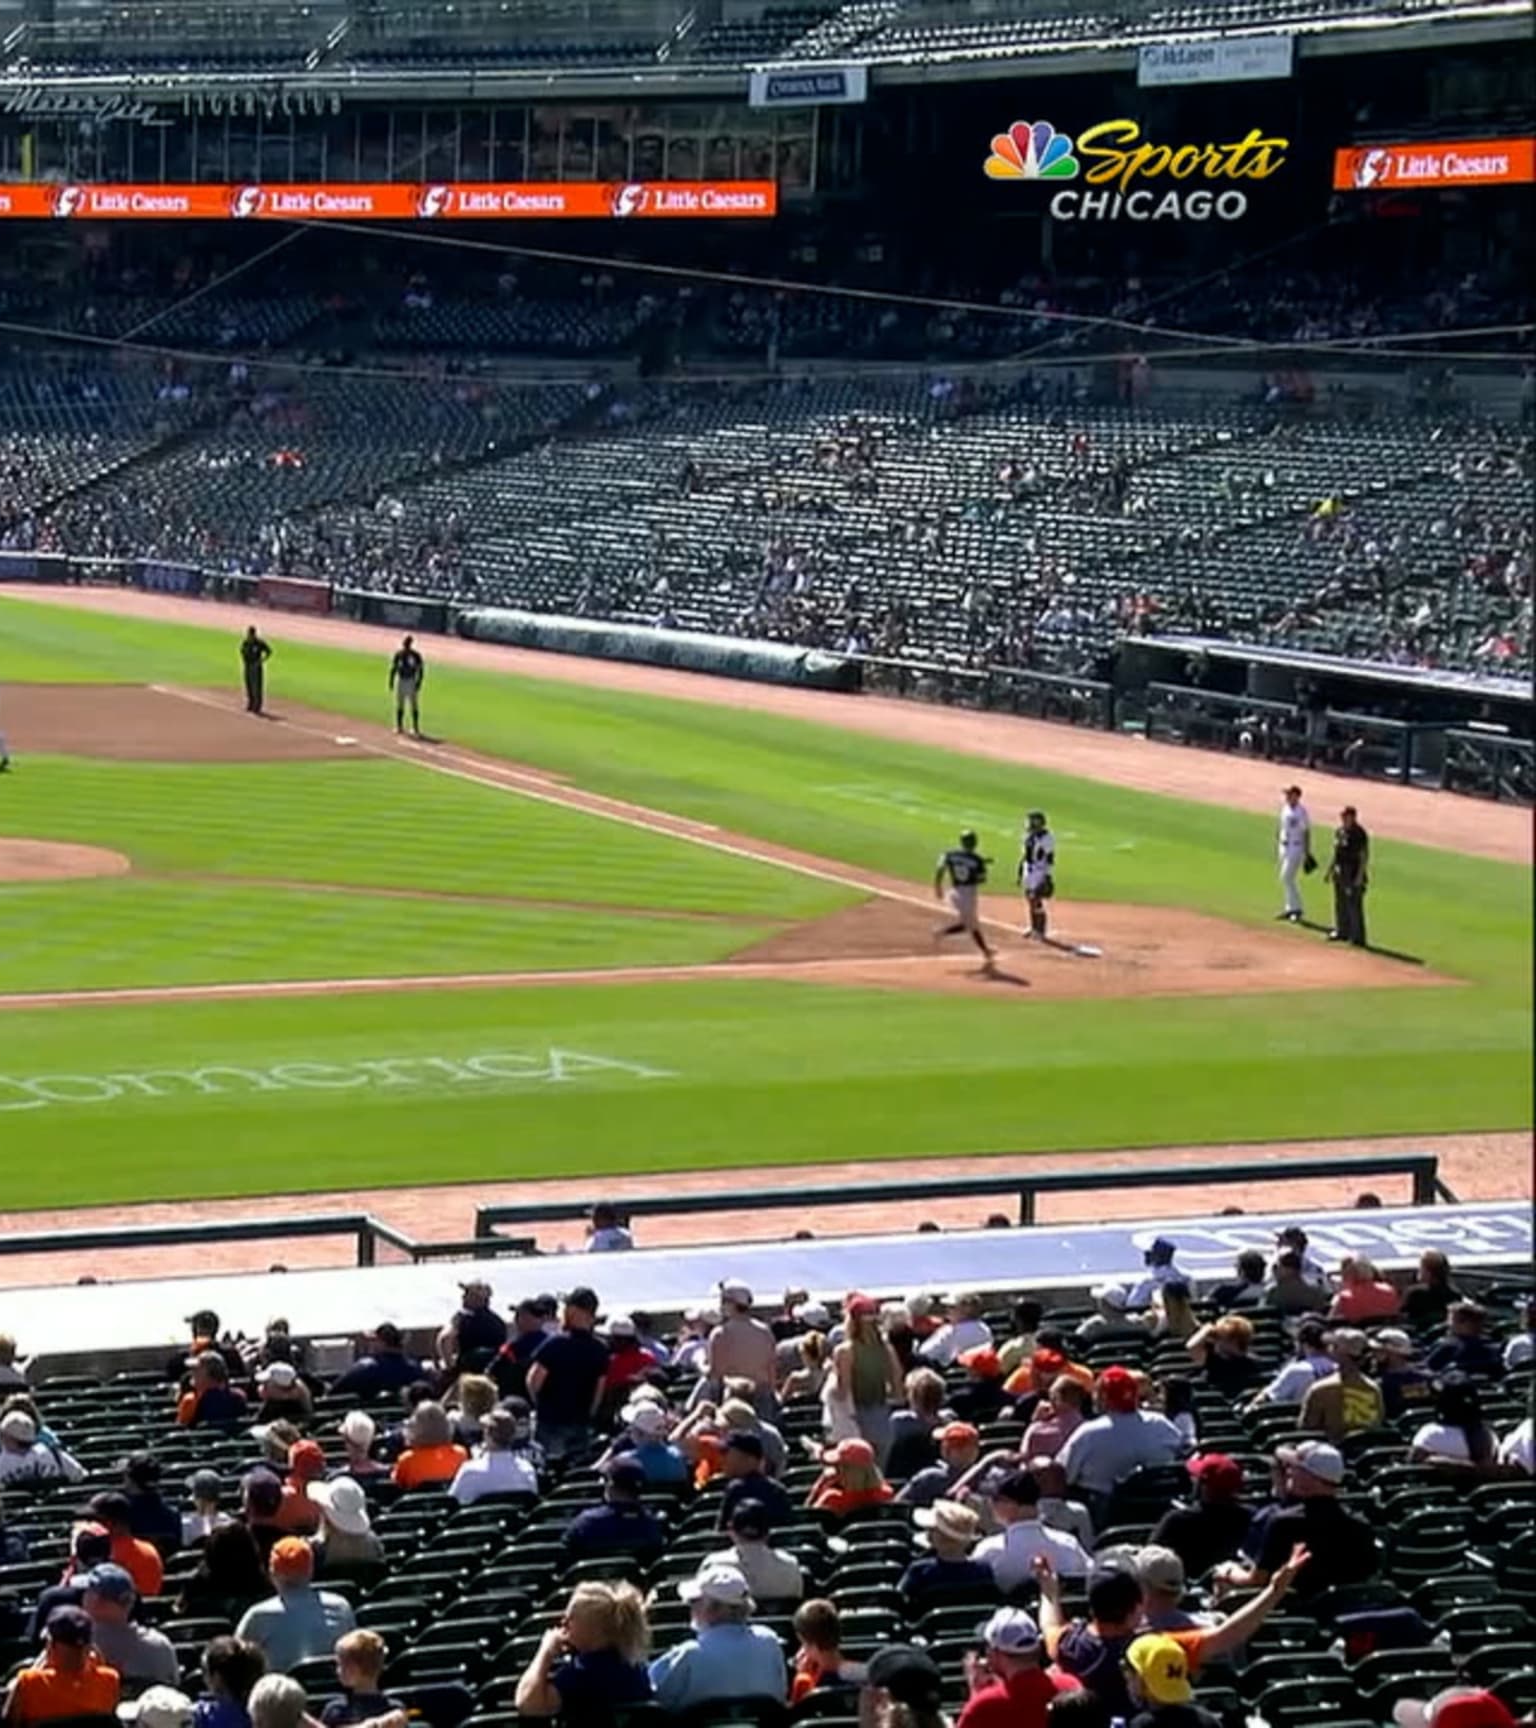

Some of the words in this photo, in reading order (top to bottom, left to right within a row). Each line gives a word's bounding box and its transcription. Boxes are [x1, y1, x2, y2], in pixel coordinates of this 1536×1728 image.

[1396, 155, 1440, 179] Little
[1443, 152, 1509, 176] Caesars
[91, 192, 129, 211] Little
[131, 192, 188, 211] Caesars
[272, 191, 311, 210] Little
[313, 191, 372, 210] Caesars
[459, 191, 501, 210] Little
[503, 191, 564, 210] Caesars
[656, 190, 698, 209] Little
[701, 190, 766, 209] Caesars
